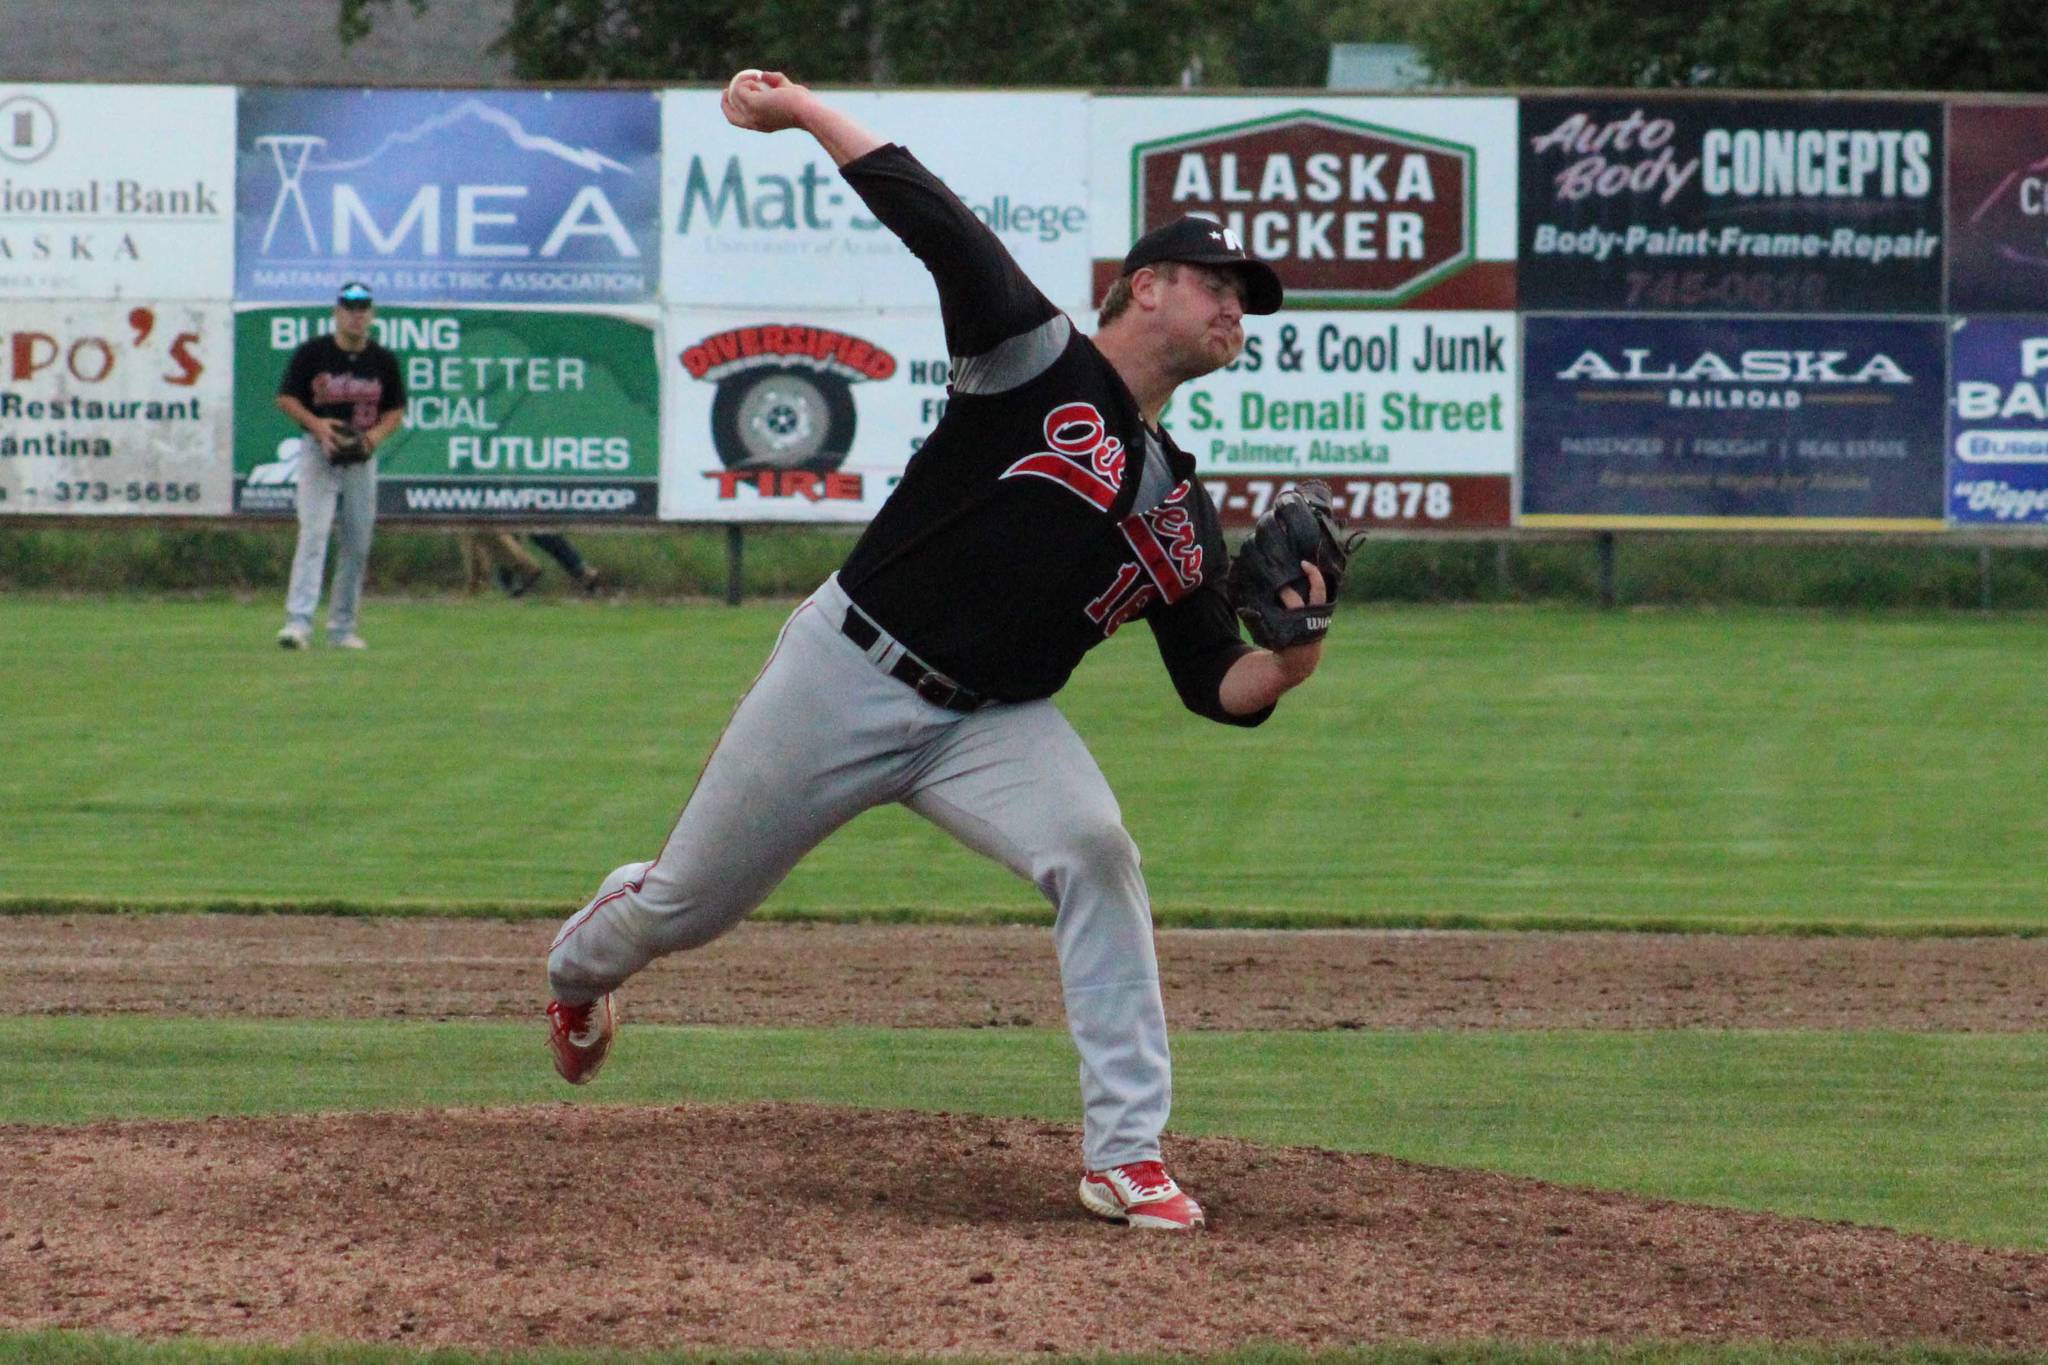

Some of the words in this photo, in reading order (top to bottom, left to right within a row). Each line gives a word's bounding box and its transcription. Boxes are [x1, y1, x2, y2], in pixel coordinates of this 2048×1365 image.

[1531, 111, 1675, 155] Auto
[1173, 153, 1435, 202] ALASKA
[1554, 147, 1699, 206] Body
[1703, 128, 1932, 198] CONCEPTS
[116, 179, 217, 214] Bank
[678, 154, 882, 234] Mat-S
[958, 192, 1087, 242] ollege
[333, 184, 641, 256] MEA
[1184, 210, 1425, 261] ICKER
[393, 272, 493, 289] ELECTRIC
[500, 272, 645, 291] ASSOCIATION
[1277, 324, 1305, 373] &
[1318, 324, 1398, 373] Cool
[1413, 325, 1506, 373] Junk
[1556, 350, 1914, 384] ALASKA
[408, 357, 585, 391] BETTER
[0, 393, 201, 421] Restaurant
[1189, 391, 1224, 431] S.
[1240, 391, 1366, 431] Denali
[1381, 391, 1505, 432] Street
[1669, 389, 1801, 409] RAILROAD
[1957, 381, 2048, 419] BA
[448, 436, 630, 469] FUTURES
[1210, 439, 1300, 468] Palmer,
[1307, 439, 1390, 465] Alaska
[702, 470, 864, 502] TIRE
